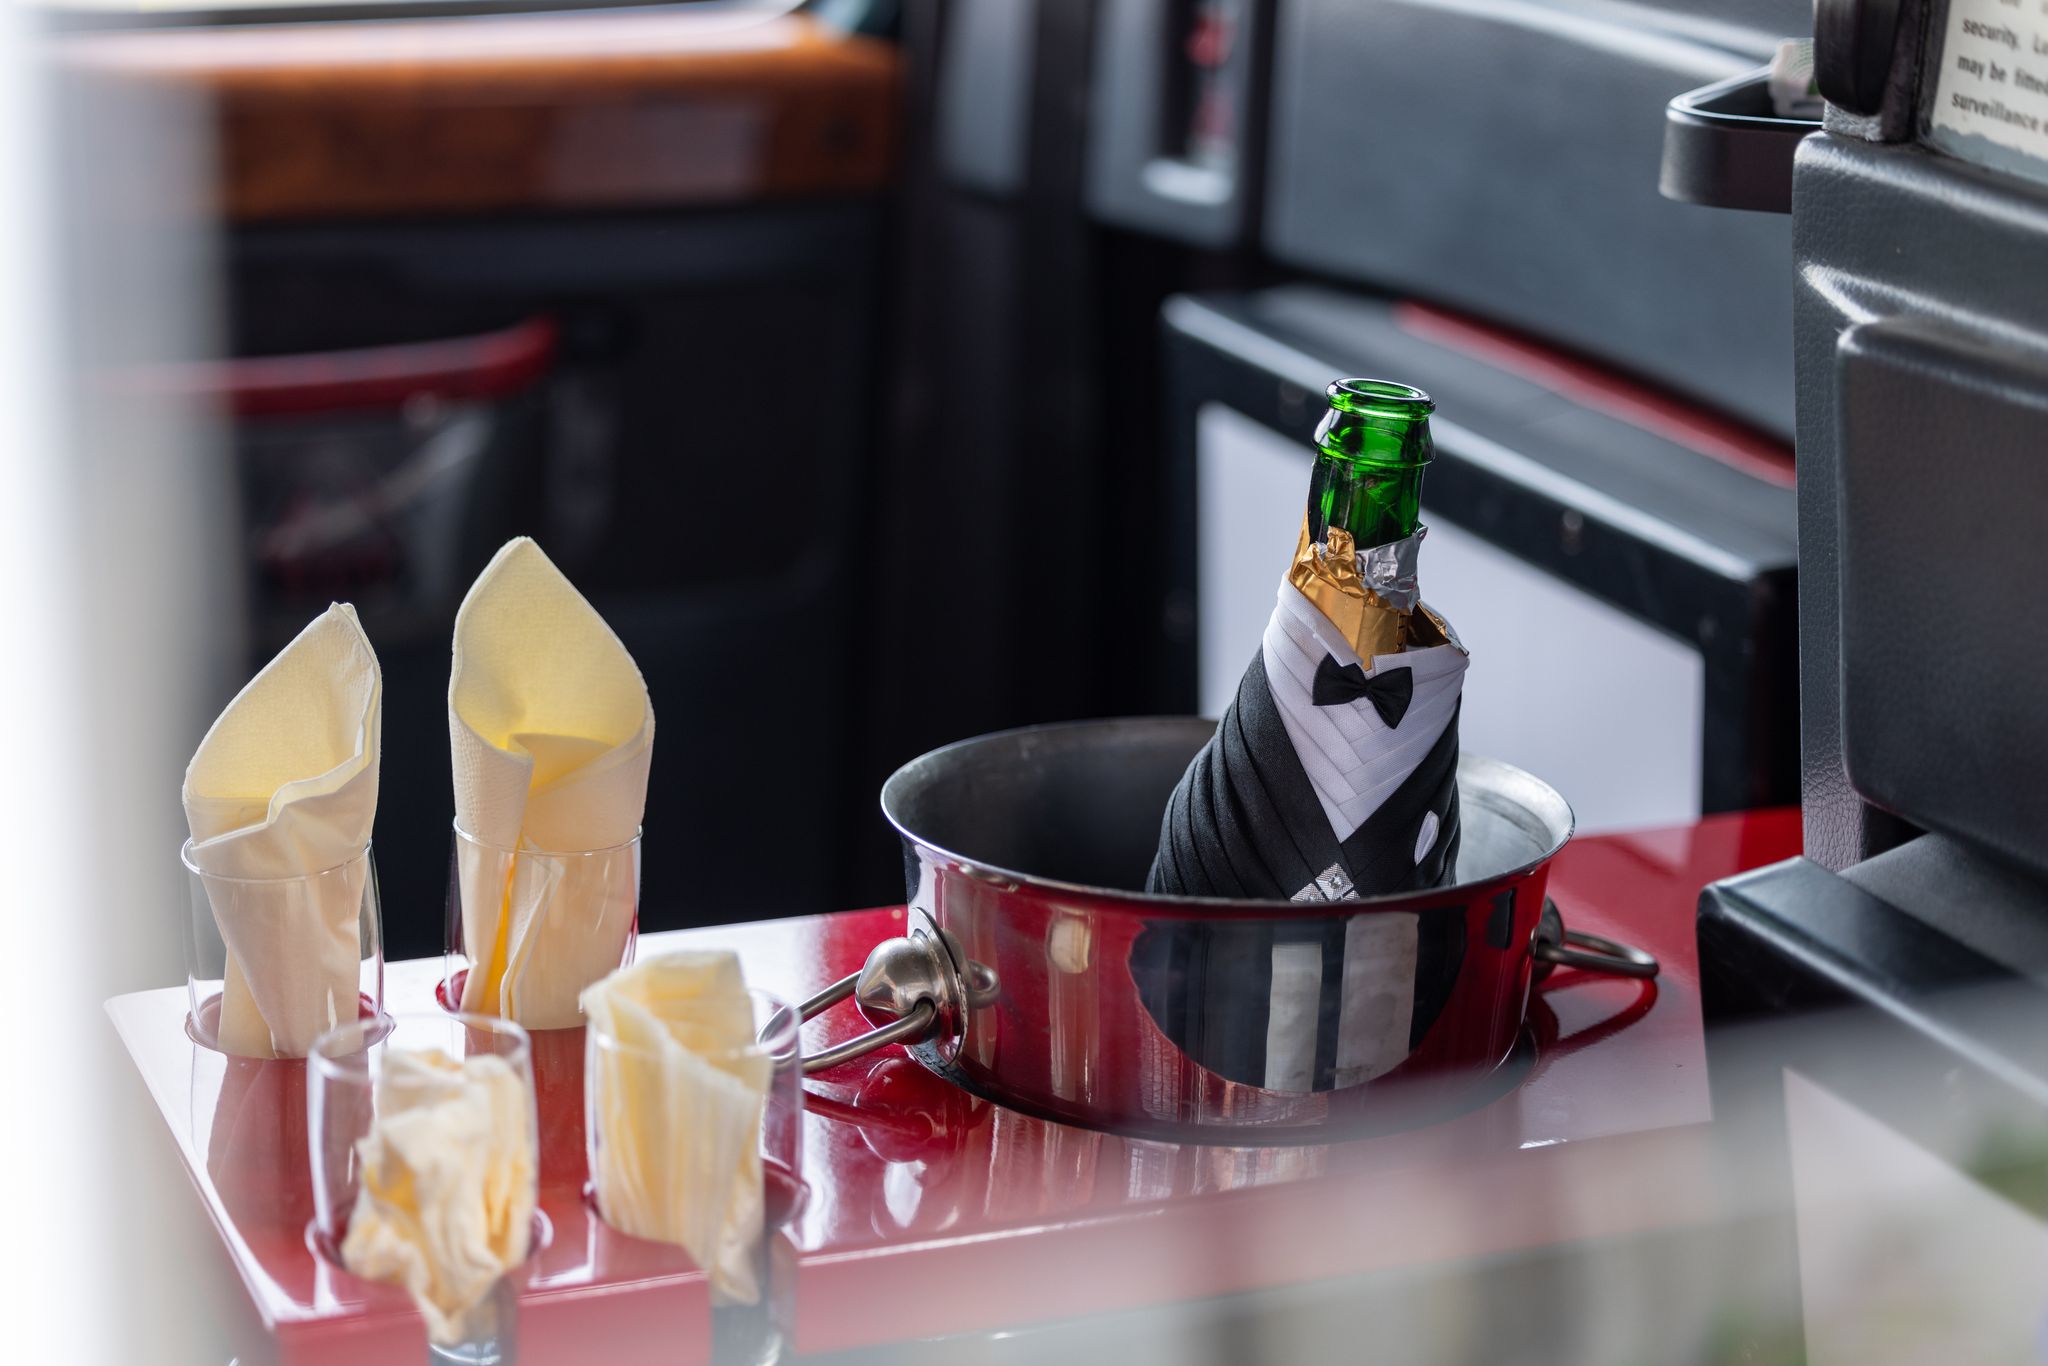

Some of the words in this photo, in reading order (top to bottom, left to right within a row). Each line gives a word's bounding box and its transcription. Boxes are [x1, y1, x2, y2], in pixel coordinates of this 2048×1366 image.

[1957, 55, 1984, 81] may
[1989, 59, 2007, 82] be
[1951, 92, 2038, 131] surveillance
